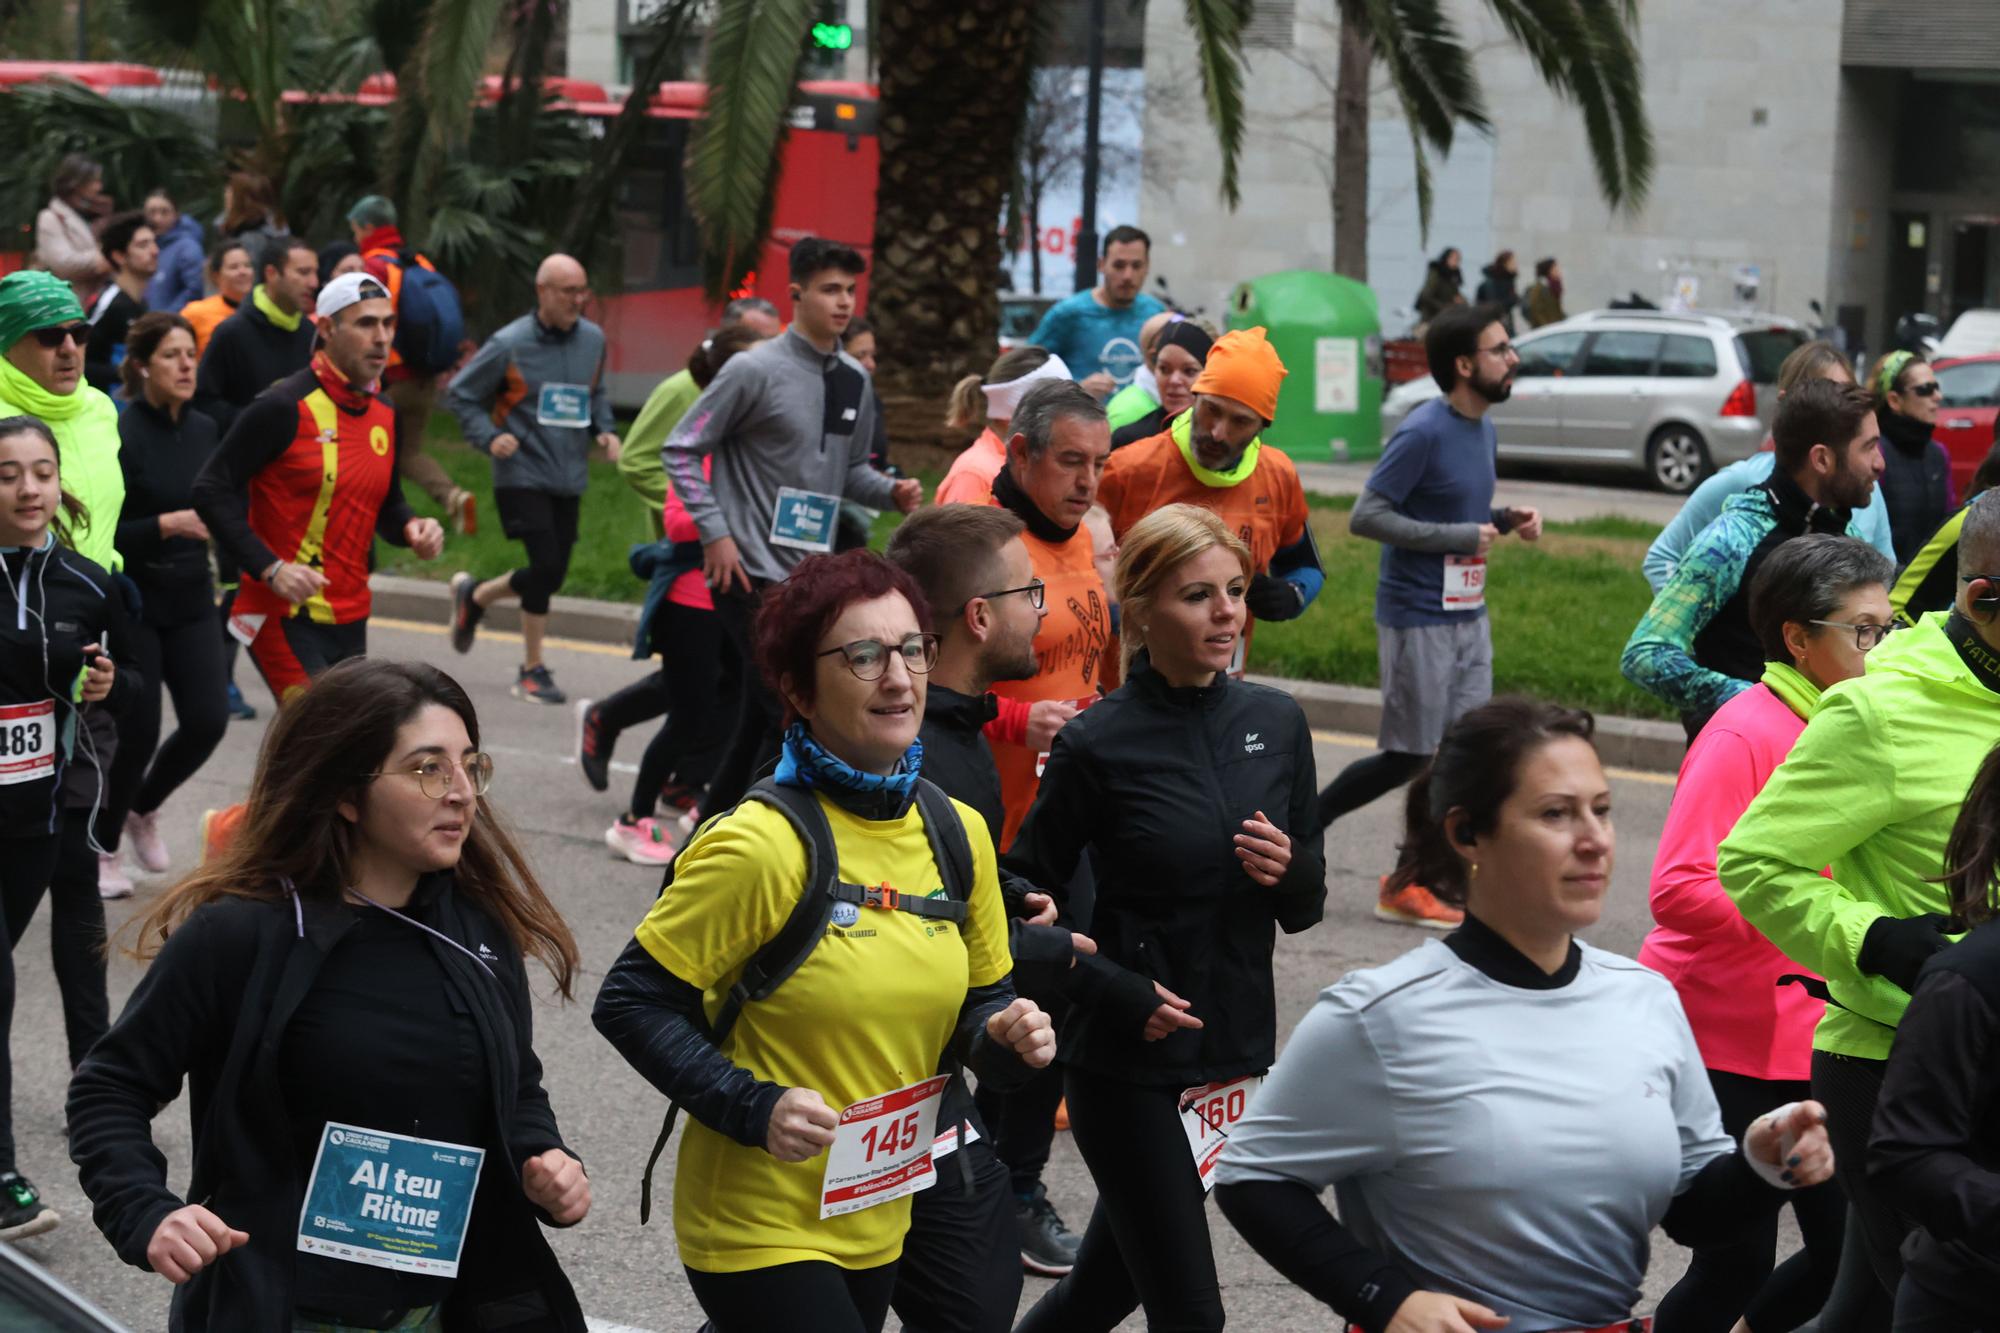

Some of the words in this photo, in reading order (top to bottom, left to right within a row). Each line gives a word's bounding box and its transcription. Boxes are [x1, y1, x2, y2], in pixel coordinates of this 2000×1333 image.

[861, 1110, 920, 1163] 145
[349, 1159, 390, 1191] Al
[394, 1168, 442, 1200] teu
[361, 1192, 440, 1229] Ritme
